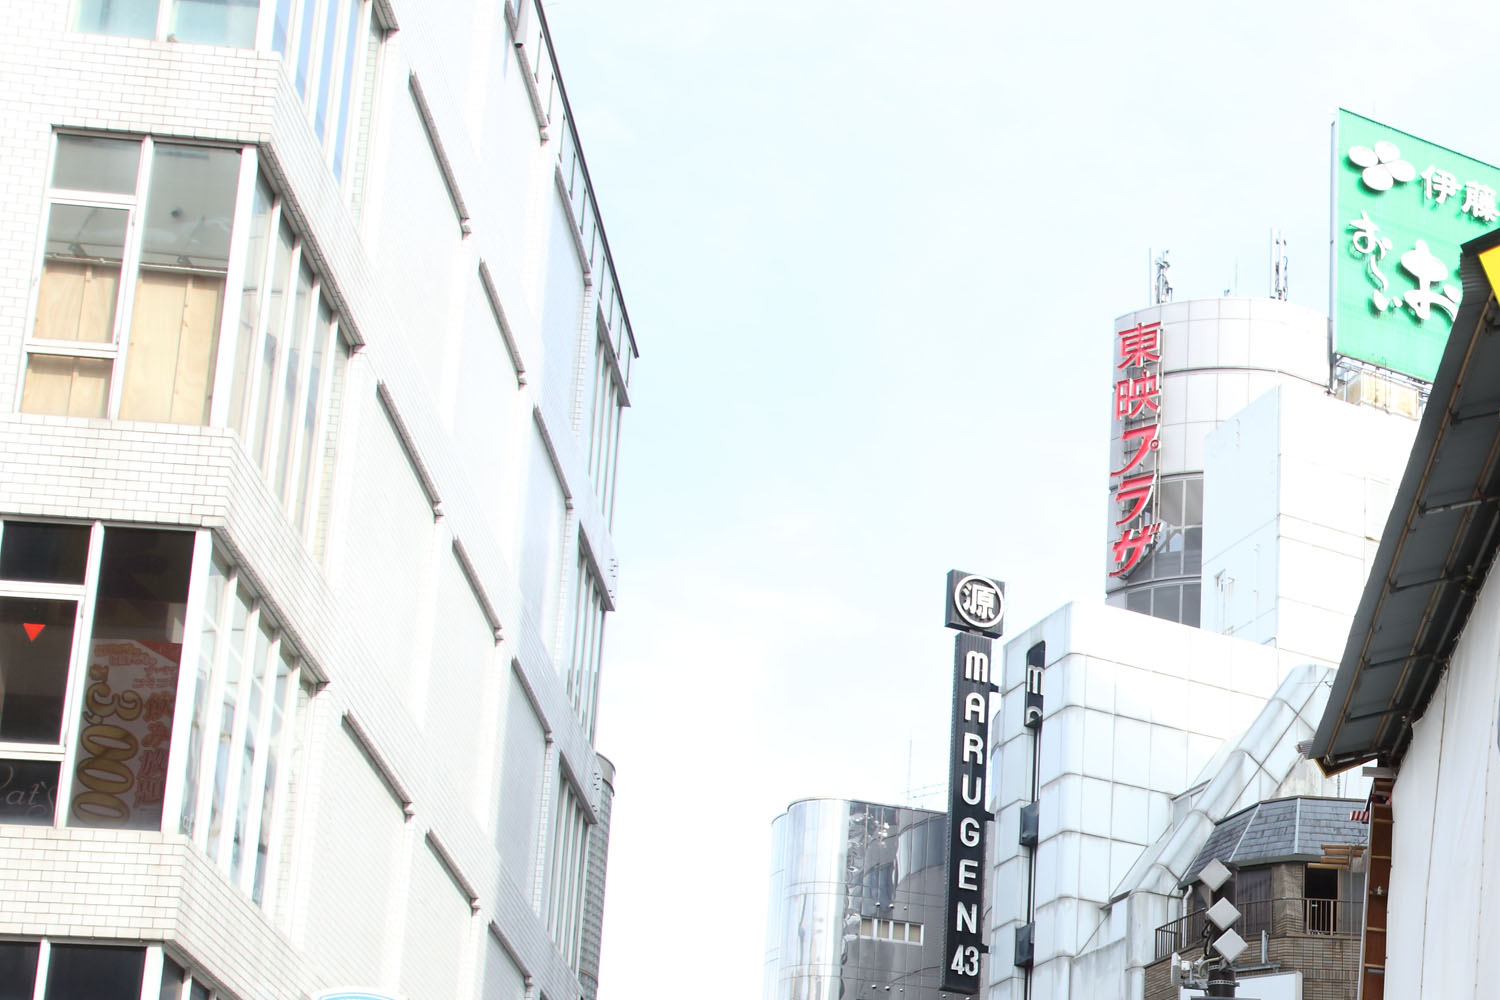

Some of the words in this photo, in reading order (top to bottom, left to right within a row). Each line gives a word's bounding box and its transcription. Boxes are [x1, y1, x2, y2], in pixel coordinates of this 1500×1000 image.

[1108, 320, 1163, 578] 東映プラザ
[959, 578, 1000, 624] 源
[956, 650, 989, 934] MARUGEN
[951, 944, 980, 976] 43
